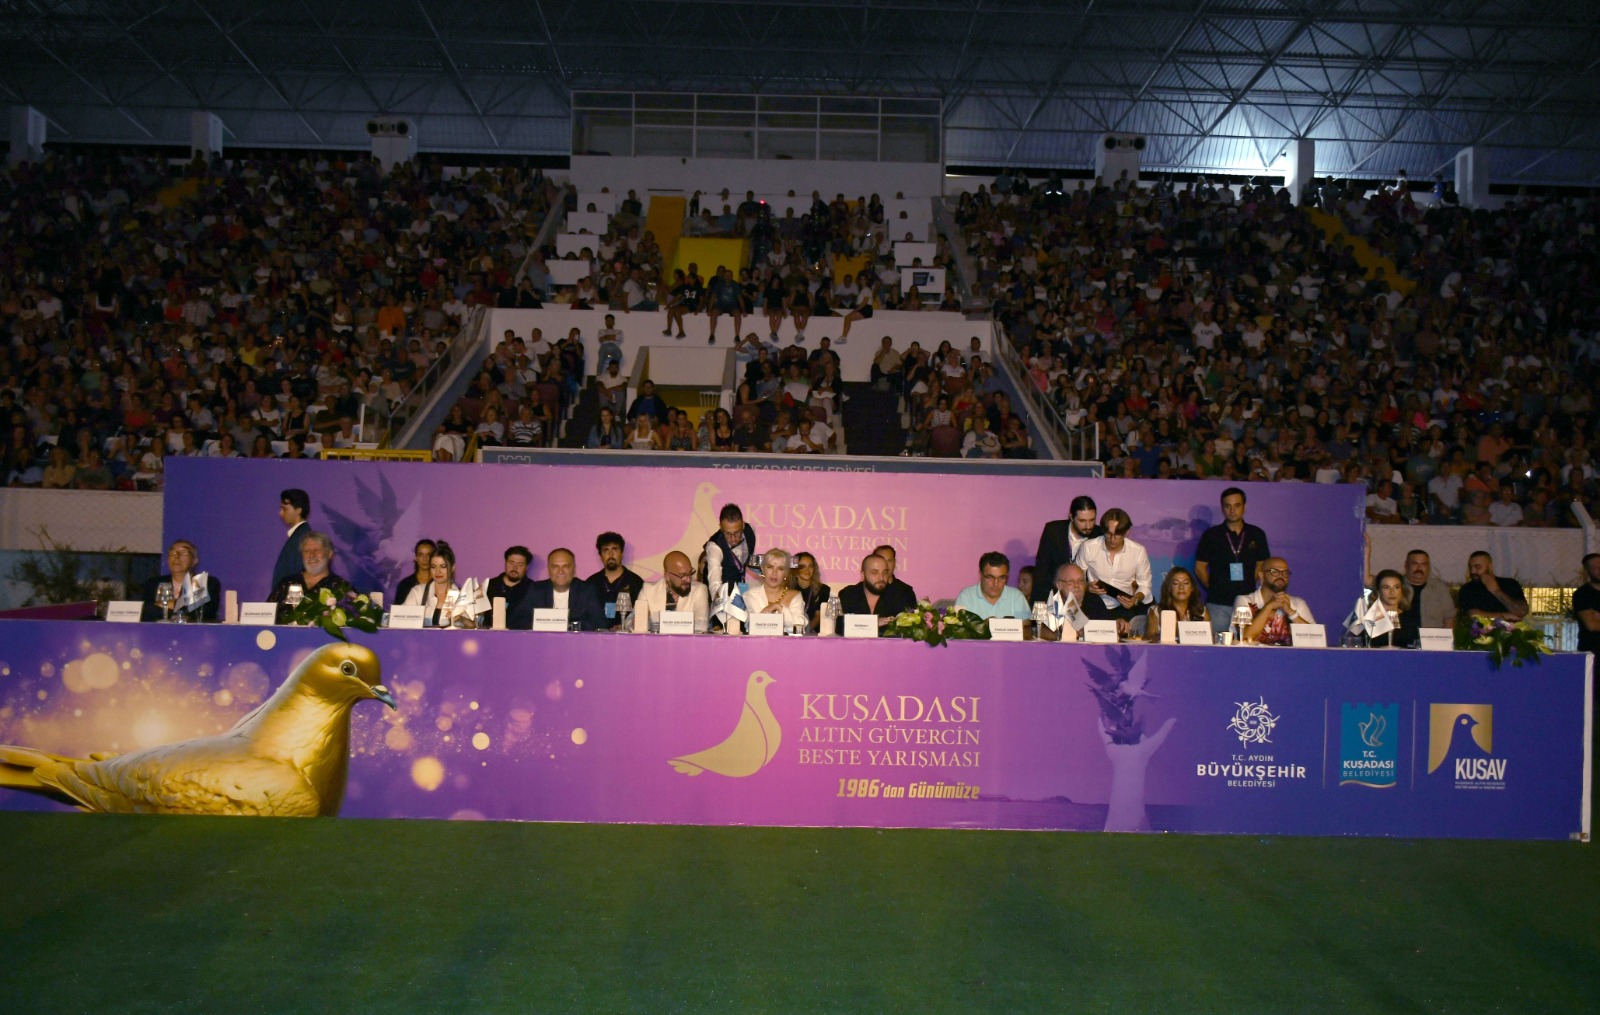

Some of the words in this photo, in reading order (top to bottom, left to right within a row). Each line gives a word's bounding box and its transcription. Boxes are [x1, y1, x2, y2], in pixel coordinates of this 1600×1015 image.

[744, 503, 909, 533] KUŞADASI
[756, 534, 801, 550] LTIN
[805, 531, 909, 551] GÜVERCİN
[800, 693, 982, 723] KUŞADASI
[798, 726, 864, 743] ALTIN
[868, 725, 981, 745] GÜVERCİN
[798, 749, 861, 765] BESTE
[867, 750, 981, 768] YARIŞMASI
[1362, 750, 1377, 758] T.C.
[1197, 762, 1306, 780] BÜYÜKŞEHİR
[1343, 760, 1394, 769] KUŞADASI
[1343, 769, 1394, 777] BELEDİYESİ
[1455, 758, 1507, 780] KUSAV
[908, 781, 981, 799] Günümüze
[1227, 779, 1275, 788] BELEDİYESİ
